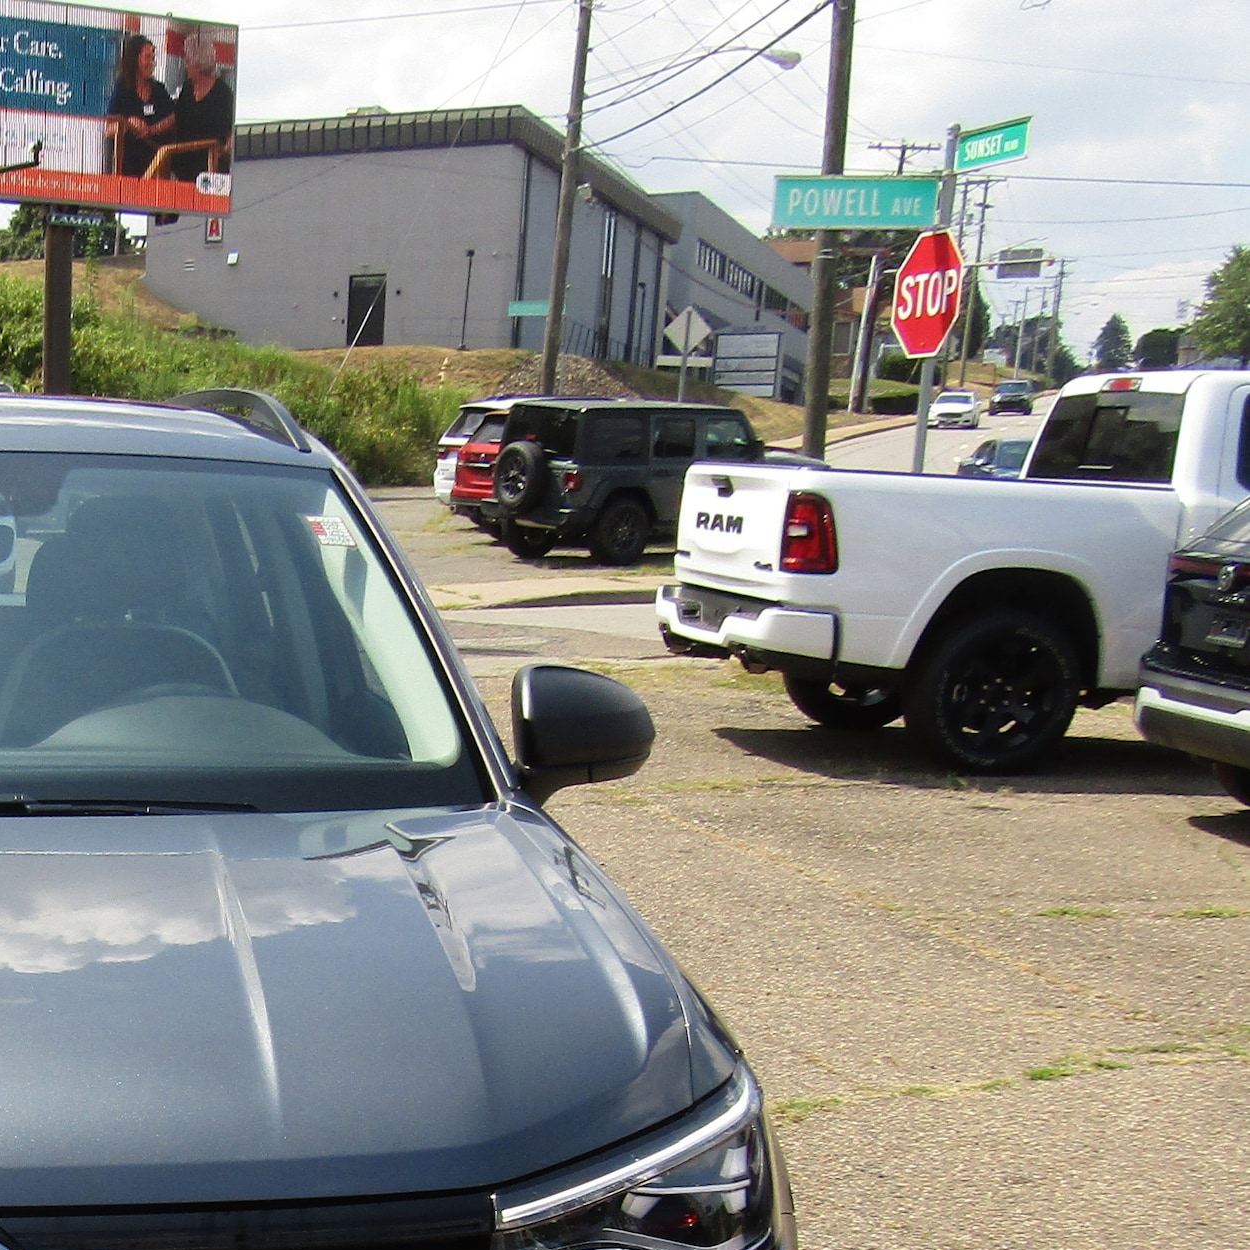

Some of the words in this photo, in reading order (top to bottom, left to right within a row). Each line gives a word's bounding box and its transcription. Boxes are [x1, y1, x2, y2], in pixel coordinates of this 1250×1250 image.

[963, 133, 1004, 162] SUNSET
[788, 188, 881, 217] POWELL
[890, 197, 921, 217] AVE
[50, 215, 102, 227] LAMAR
[897, 268, 958, 321] STOP
[696, 512, 744, 535] RAM
